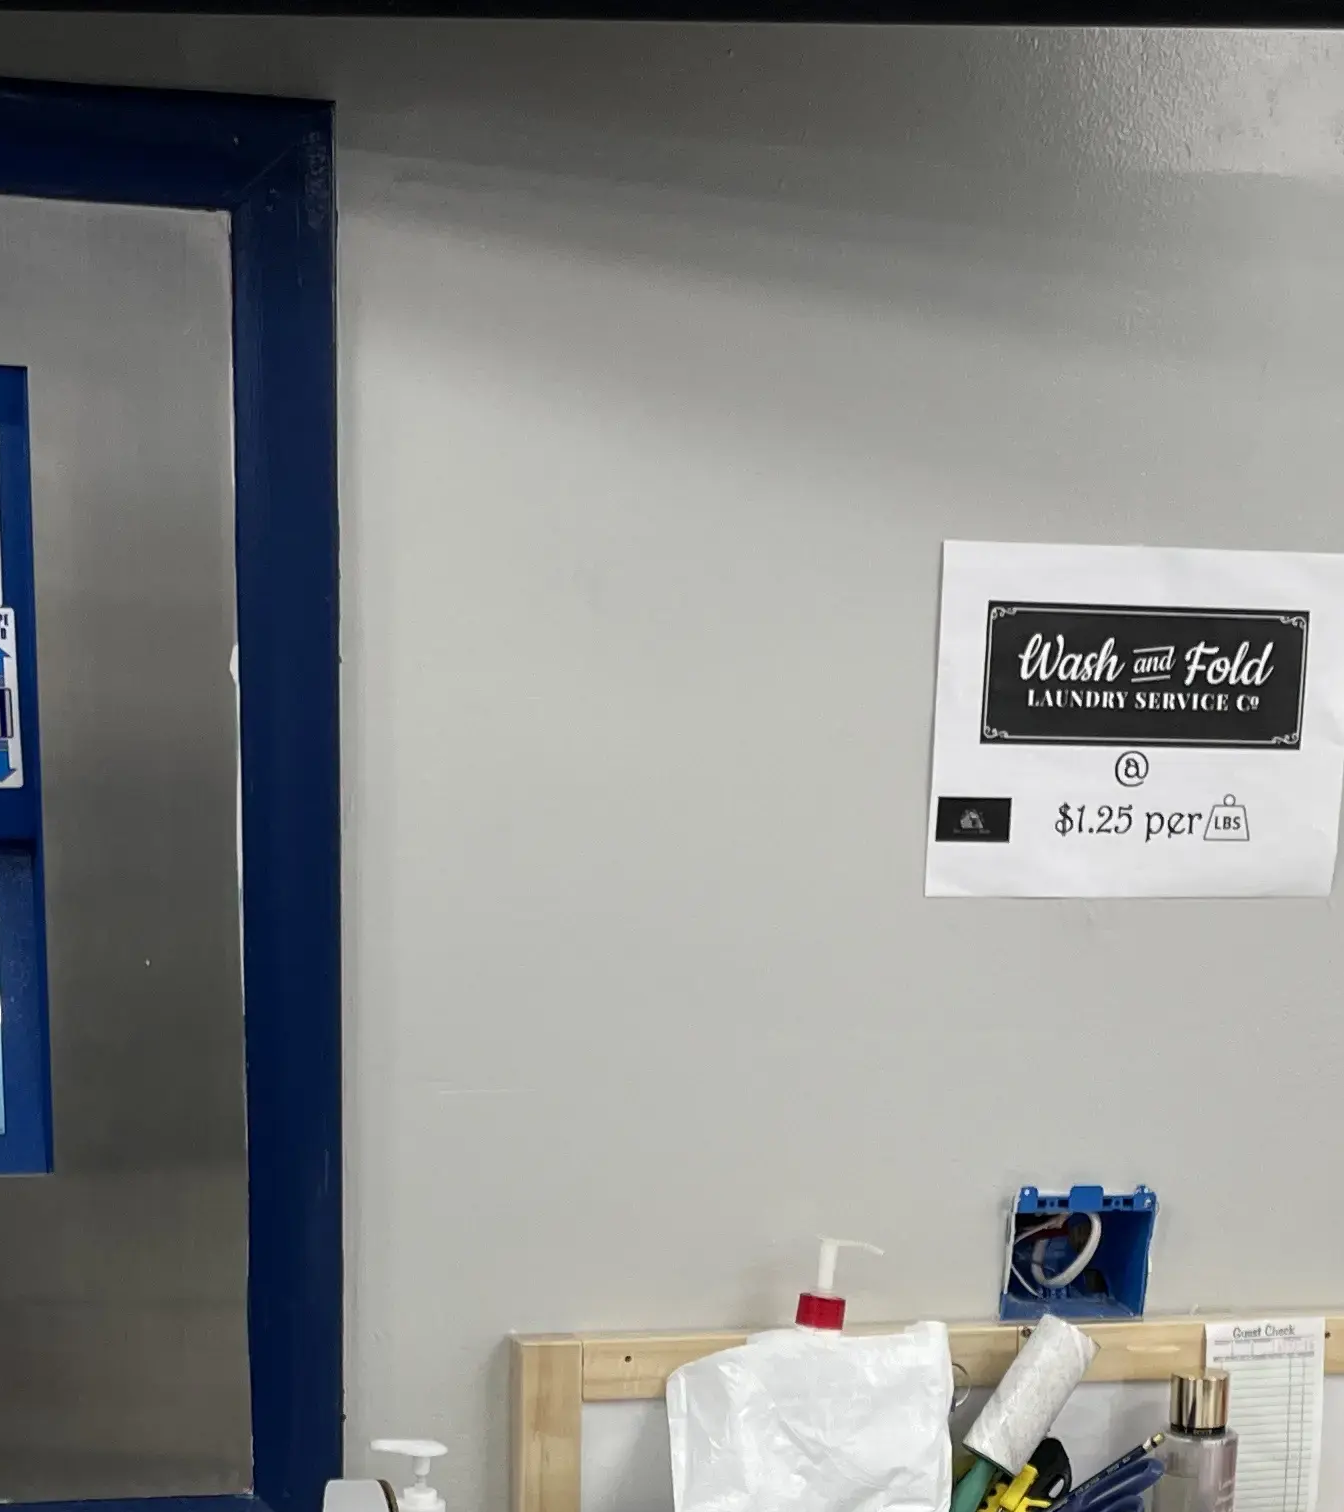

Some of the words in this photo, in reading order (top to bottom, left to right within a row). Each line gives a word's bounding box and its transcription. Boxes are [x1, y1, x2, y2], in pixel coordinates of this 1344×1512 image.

[1017, 632, 1127, 683] Wash
[1133, 646, 1175, 673] and
[1183, 640, 1276, 686] Fold
[1026, 688, 1130, 709] LAUNDRY
[1134, 691, 1230, 712] SERVICE
[1114, 750, 1150, 788] @
[1054, 801, 1135, 838] $1.25
[1144, 807, 1203, 843] per
[1213, 814, 1242, 831] LBS
[1264, 1323, 1297, 1337] Check
